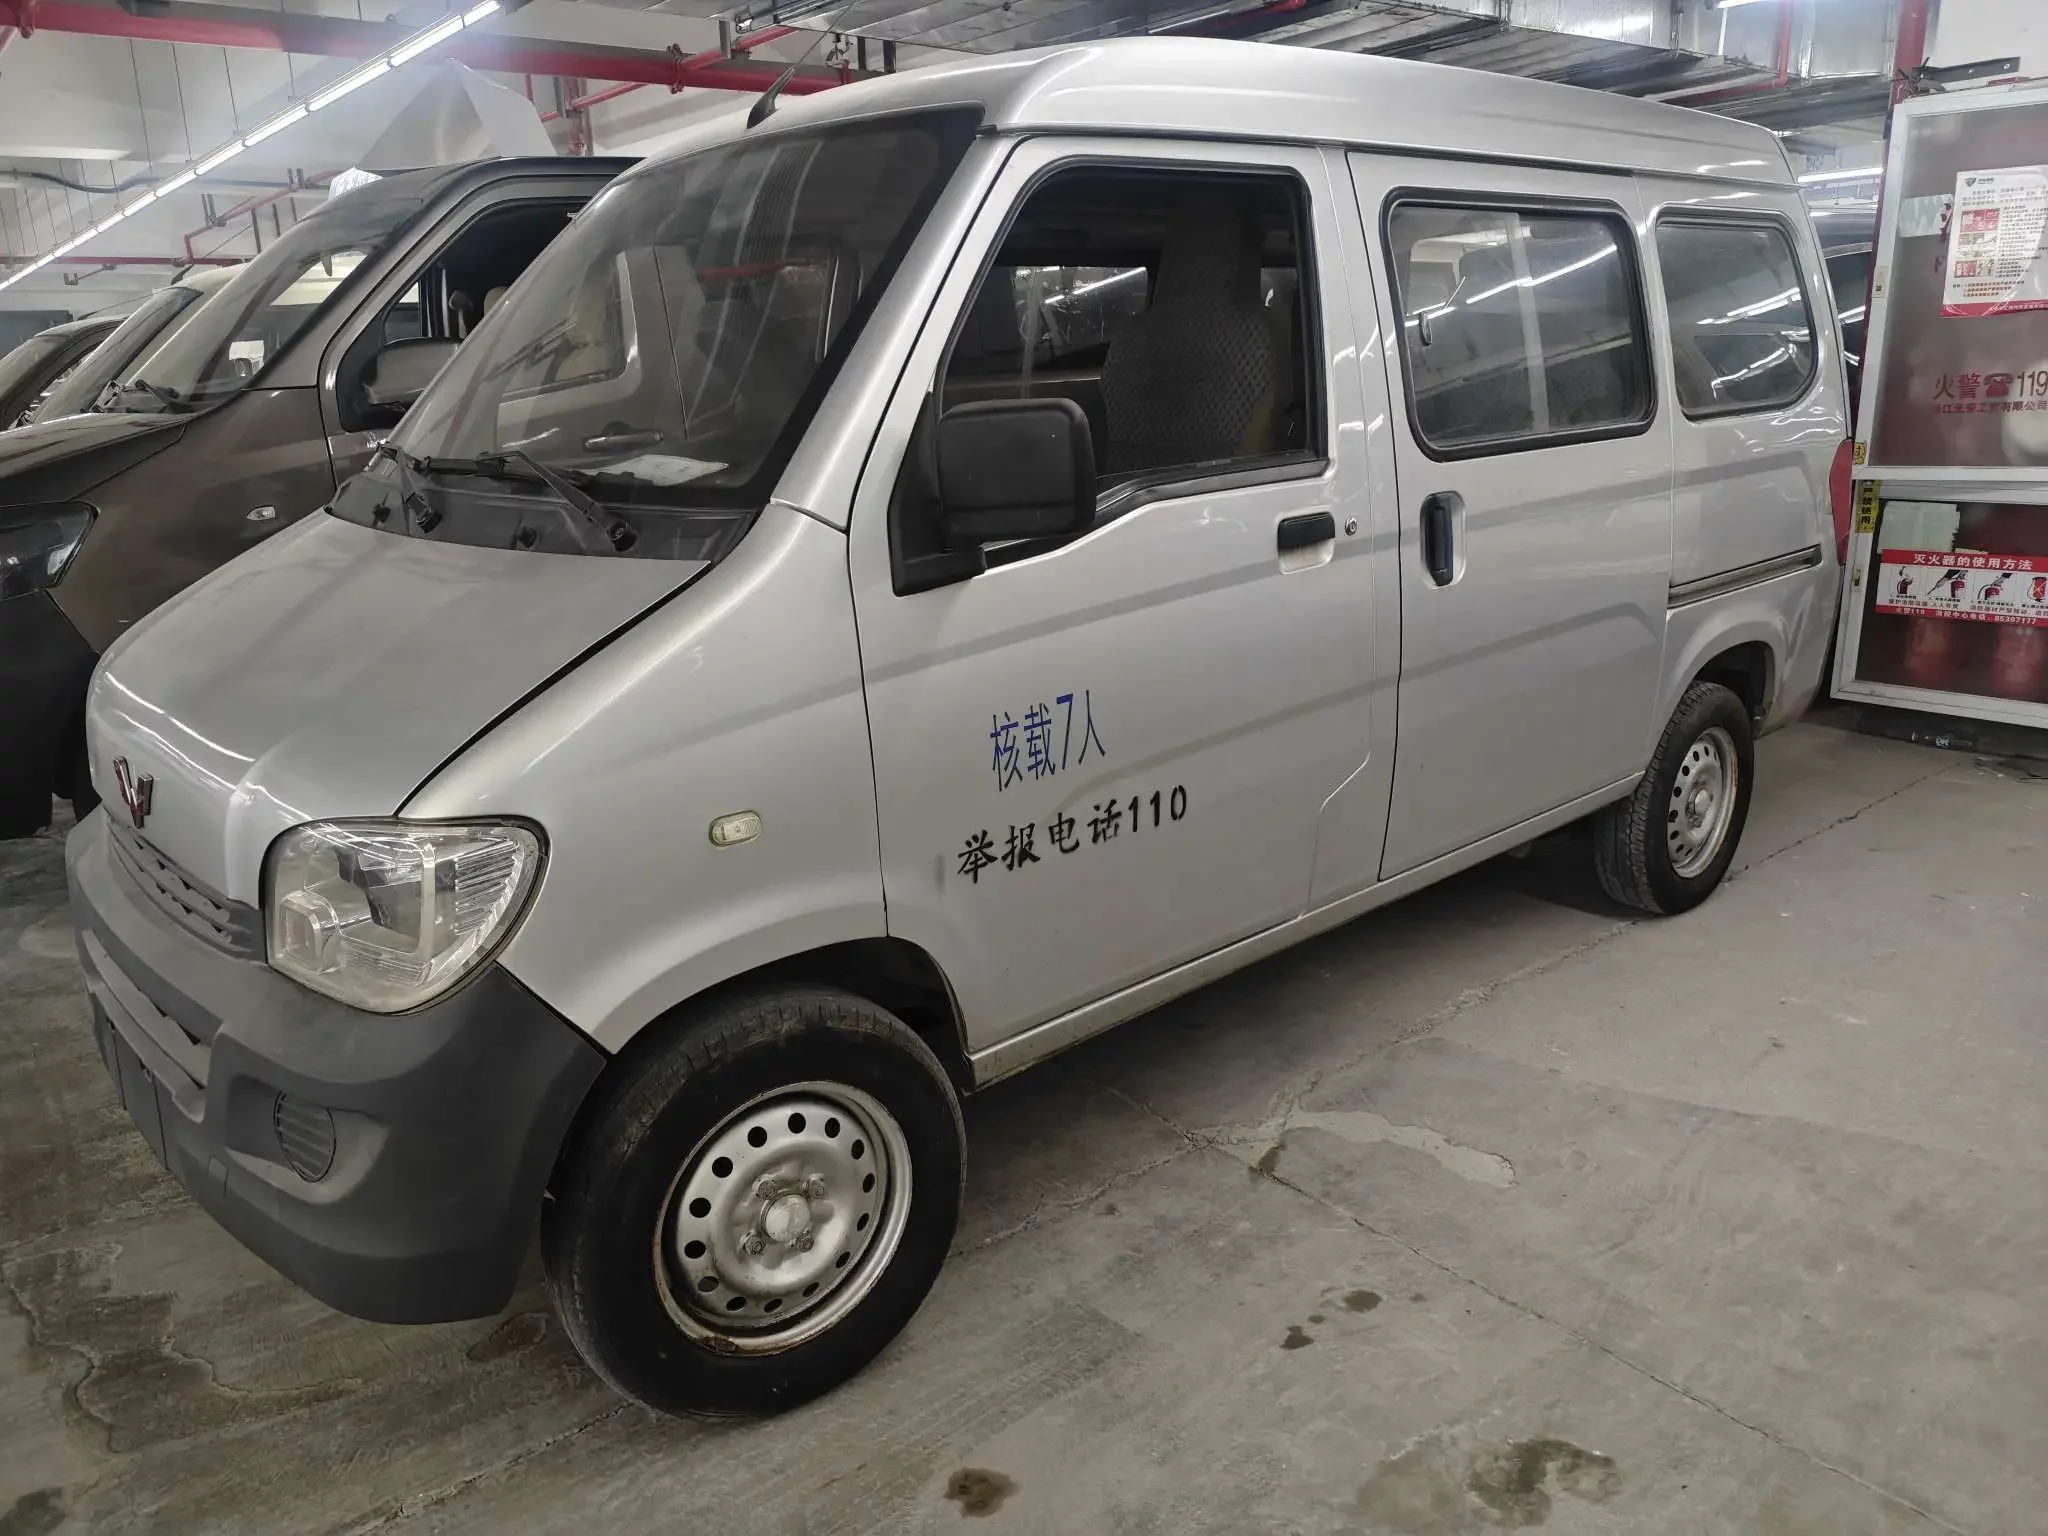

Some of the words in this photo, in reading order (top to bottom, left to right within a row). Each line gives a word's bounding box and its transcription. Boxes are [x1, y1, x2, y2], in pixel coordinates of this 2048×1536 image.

[1933, 372, 1980, 399] 火警
[2017, 371, 2048, 396] 119
[1913, 553, 2032, 570] 灭火器的使用方法
[990, 690, 1106, 791] 核载7人
[957, 785, 1188, 884] 举报电话110
